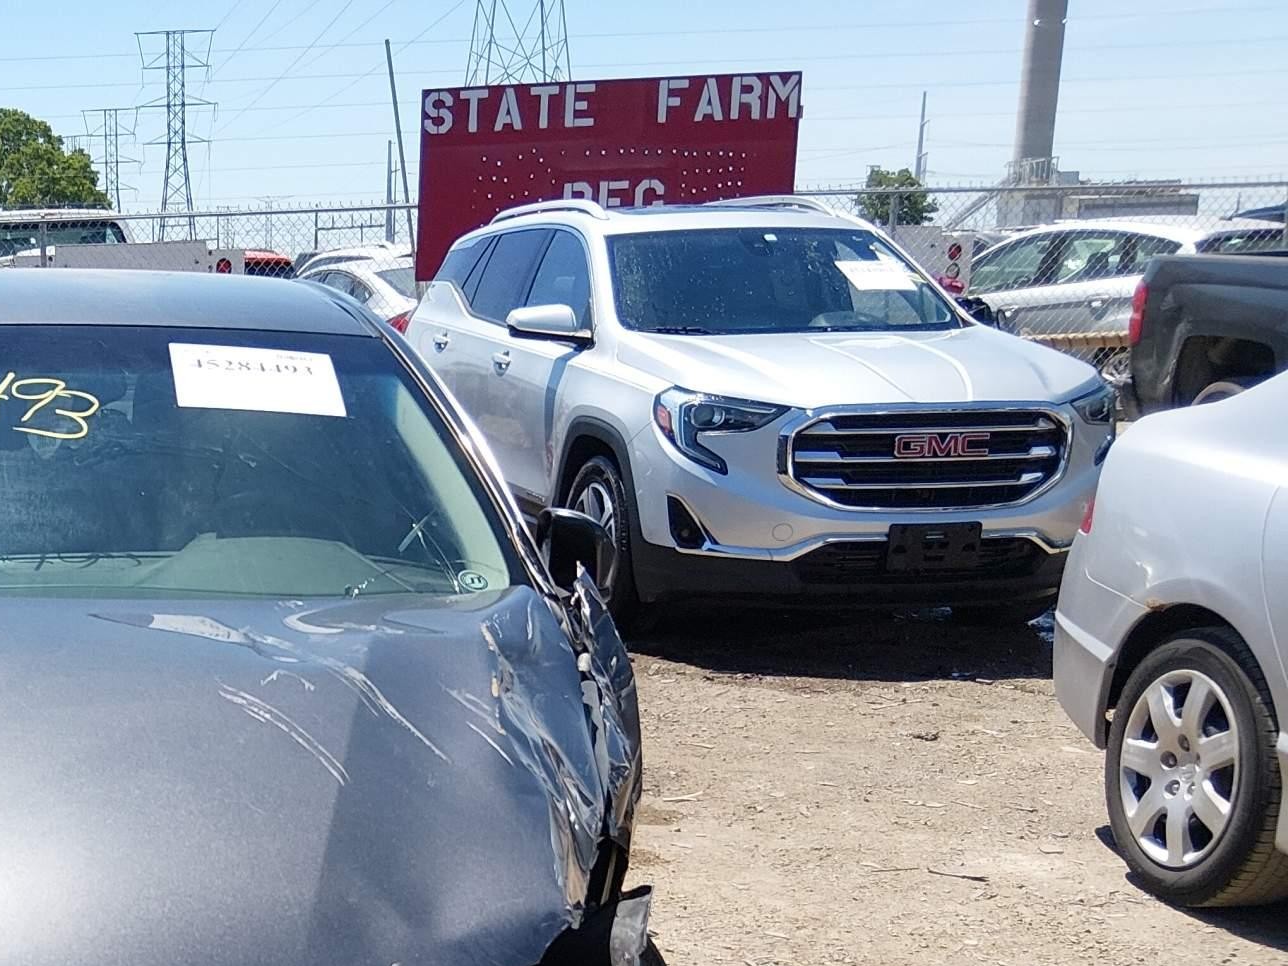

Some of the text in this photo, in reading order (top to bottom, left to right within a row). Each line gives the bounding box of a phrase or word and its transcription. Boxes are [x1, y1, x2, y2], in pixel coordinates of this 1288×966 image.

[423, 74, 800, 135] STATE FARM
[894, 432, 991, 457] GMC
